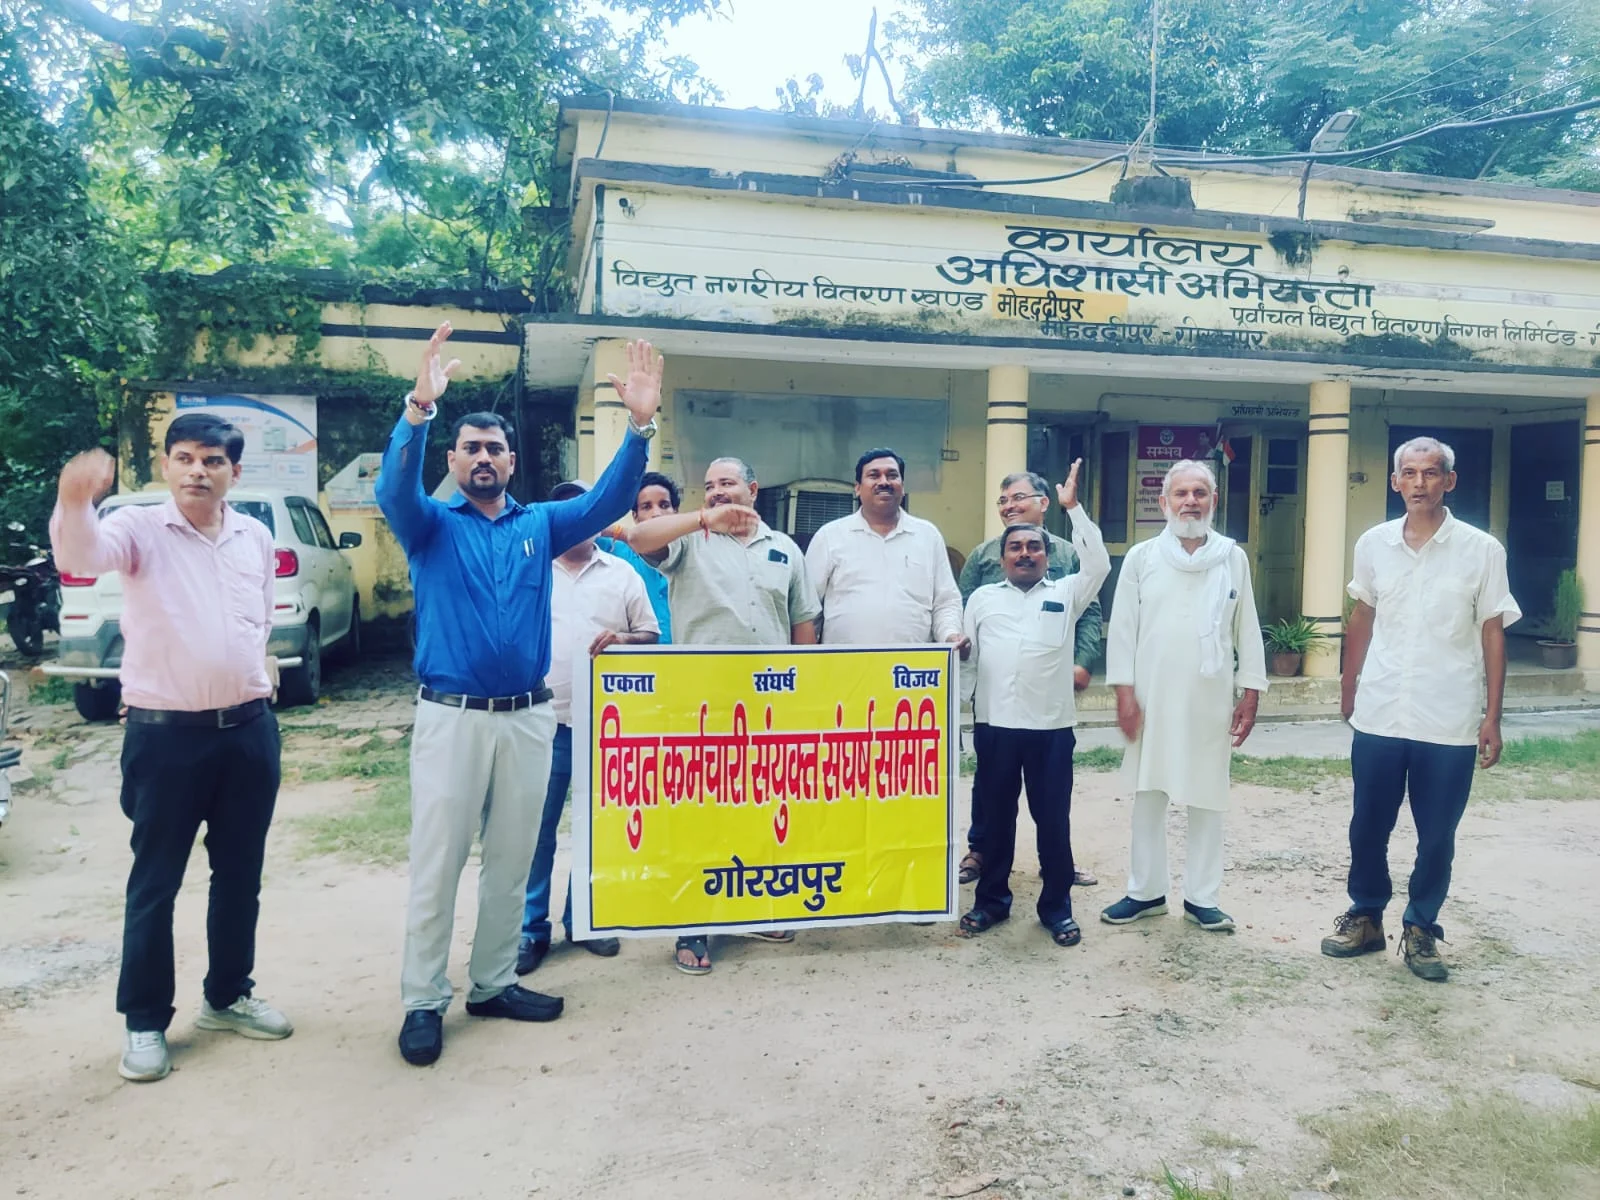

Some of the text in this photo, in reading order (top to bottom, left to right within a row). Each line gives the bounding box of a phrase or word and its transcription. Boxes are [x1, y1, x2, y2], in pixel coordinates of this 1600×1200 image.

[1005, 225, 1262, 266] कार्यालय
[610, 260, 987, 311] विद्युत नगरीय वितरण खण्ड
[936, 249, 1173, 297] अधिशासी
[1308, 304, 1366, 336] विद्युत
[1371, 309, 1441, 337] वितरण
[1444, 314, 1498, 340] निगम
[1502, 318, 1577, 346] लिमिटेड
[1146, 446, 1183, 457] सम्भव
[602, 665, 940, 693] एकता संघर्ष विजय
[600, 698, 941, 850] विद्युत कर्मचारी संयुक्त संघर्ष समिति
[703, 855, 845, 911] गोरखपुर
